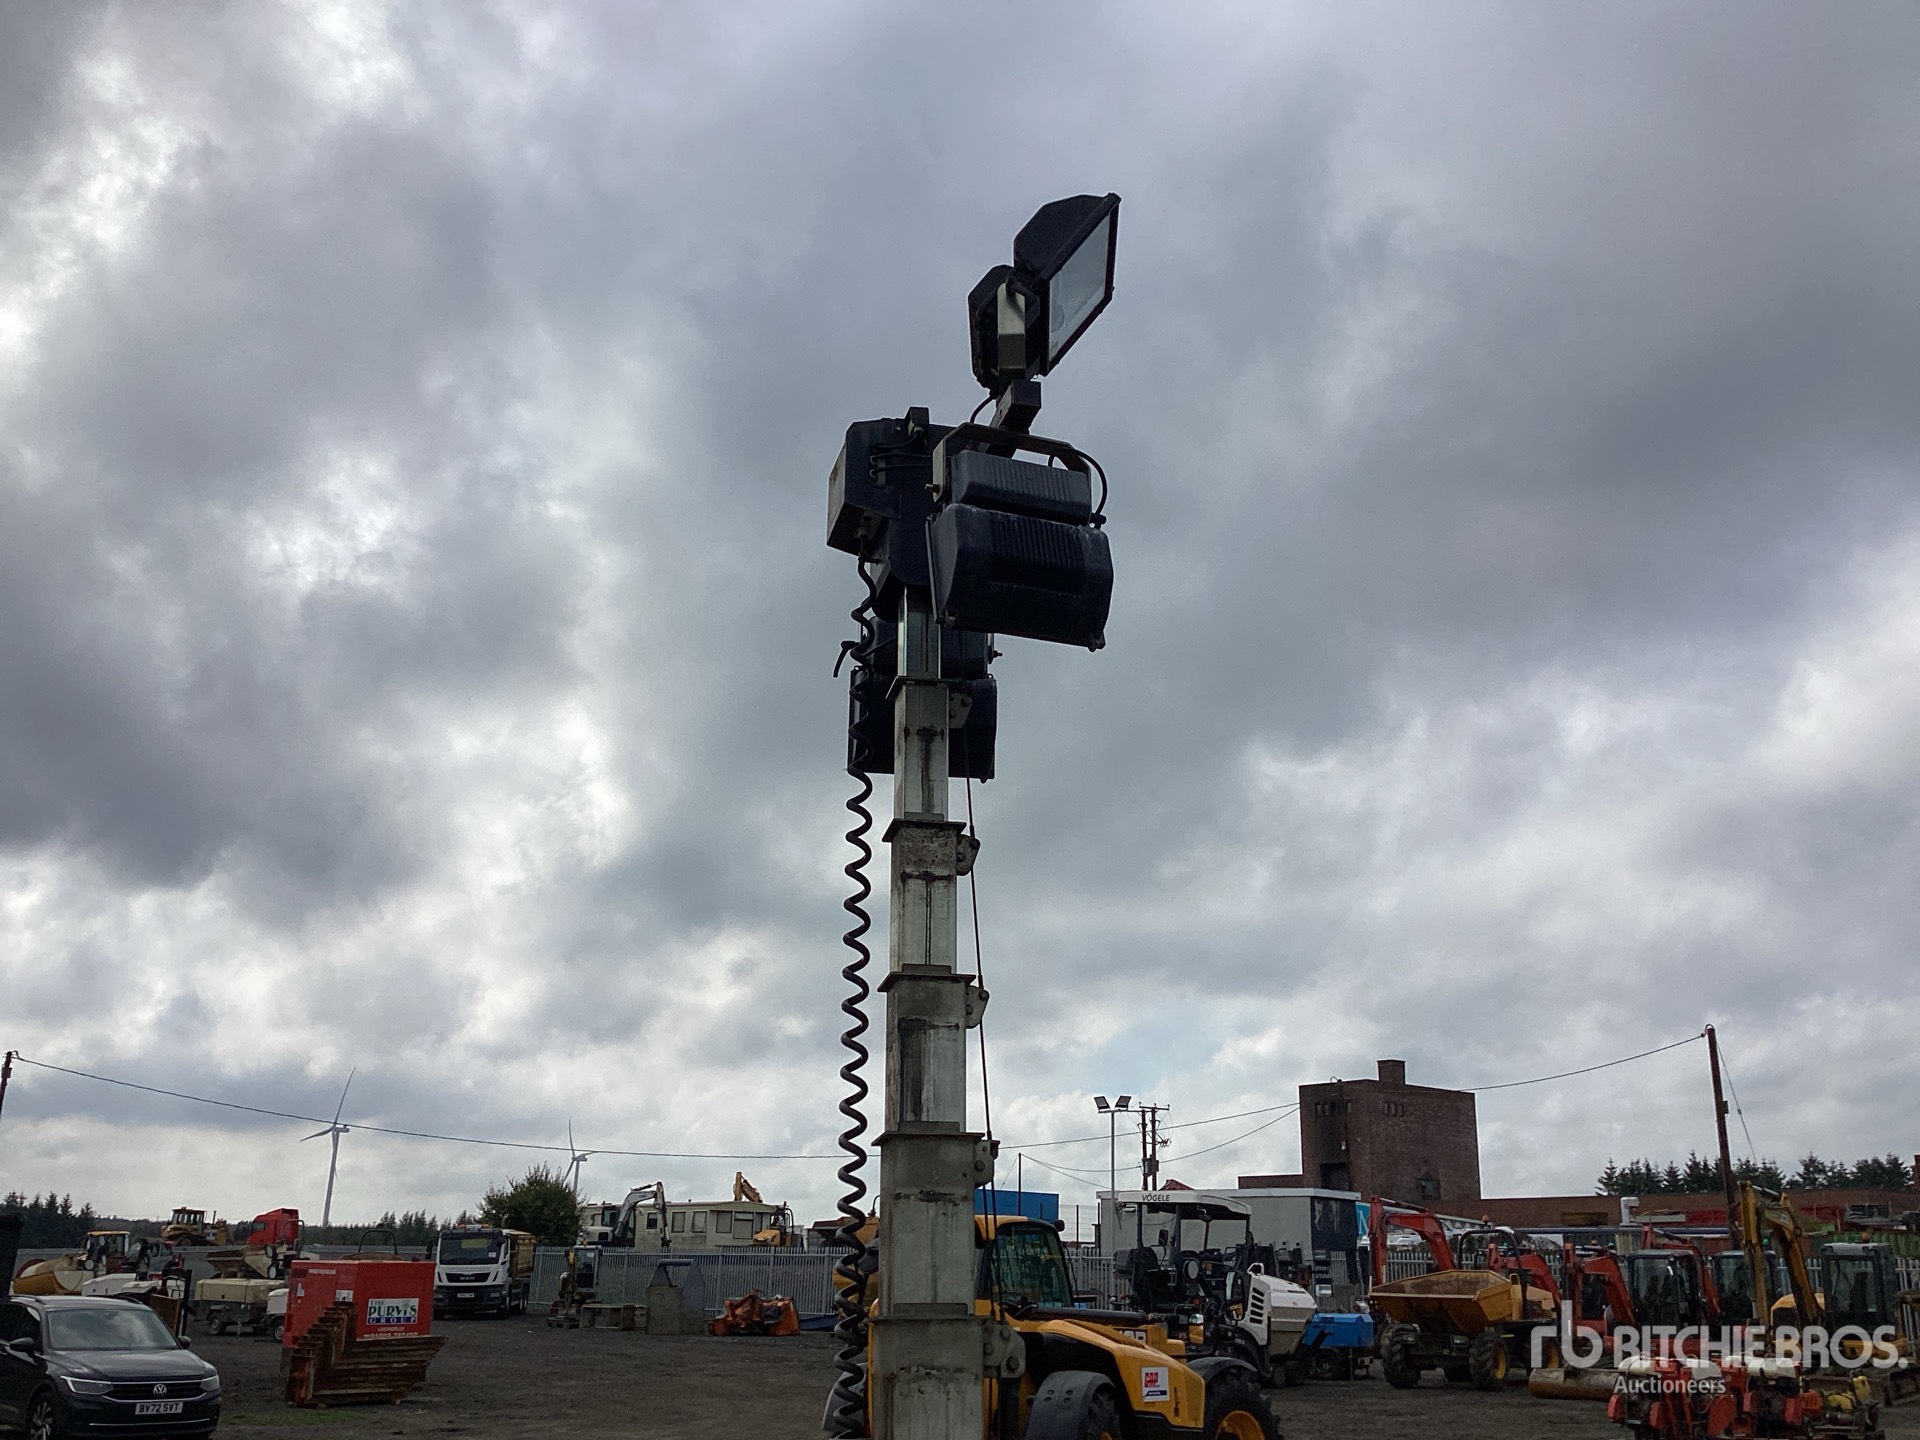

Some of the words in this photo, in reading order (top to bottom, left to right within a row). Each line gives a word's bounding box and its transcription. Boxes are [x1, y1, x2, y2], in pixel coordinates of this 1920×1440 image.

[1141, 1193, 1170, 1201] VÖGELE
[368, 1304, 417, 1317] PURVIS
[369, 1316, 416, 1324] GROUP
[139, 1403, 161, 1414] BV72
[163, 1402, 180, 1412] SVT
